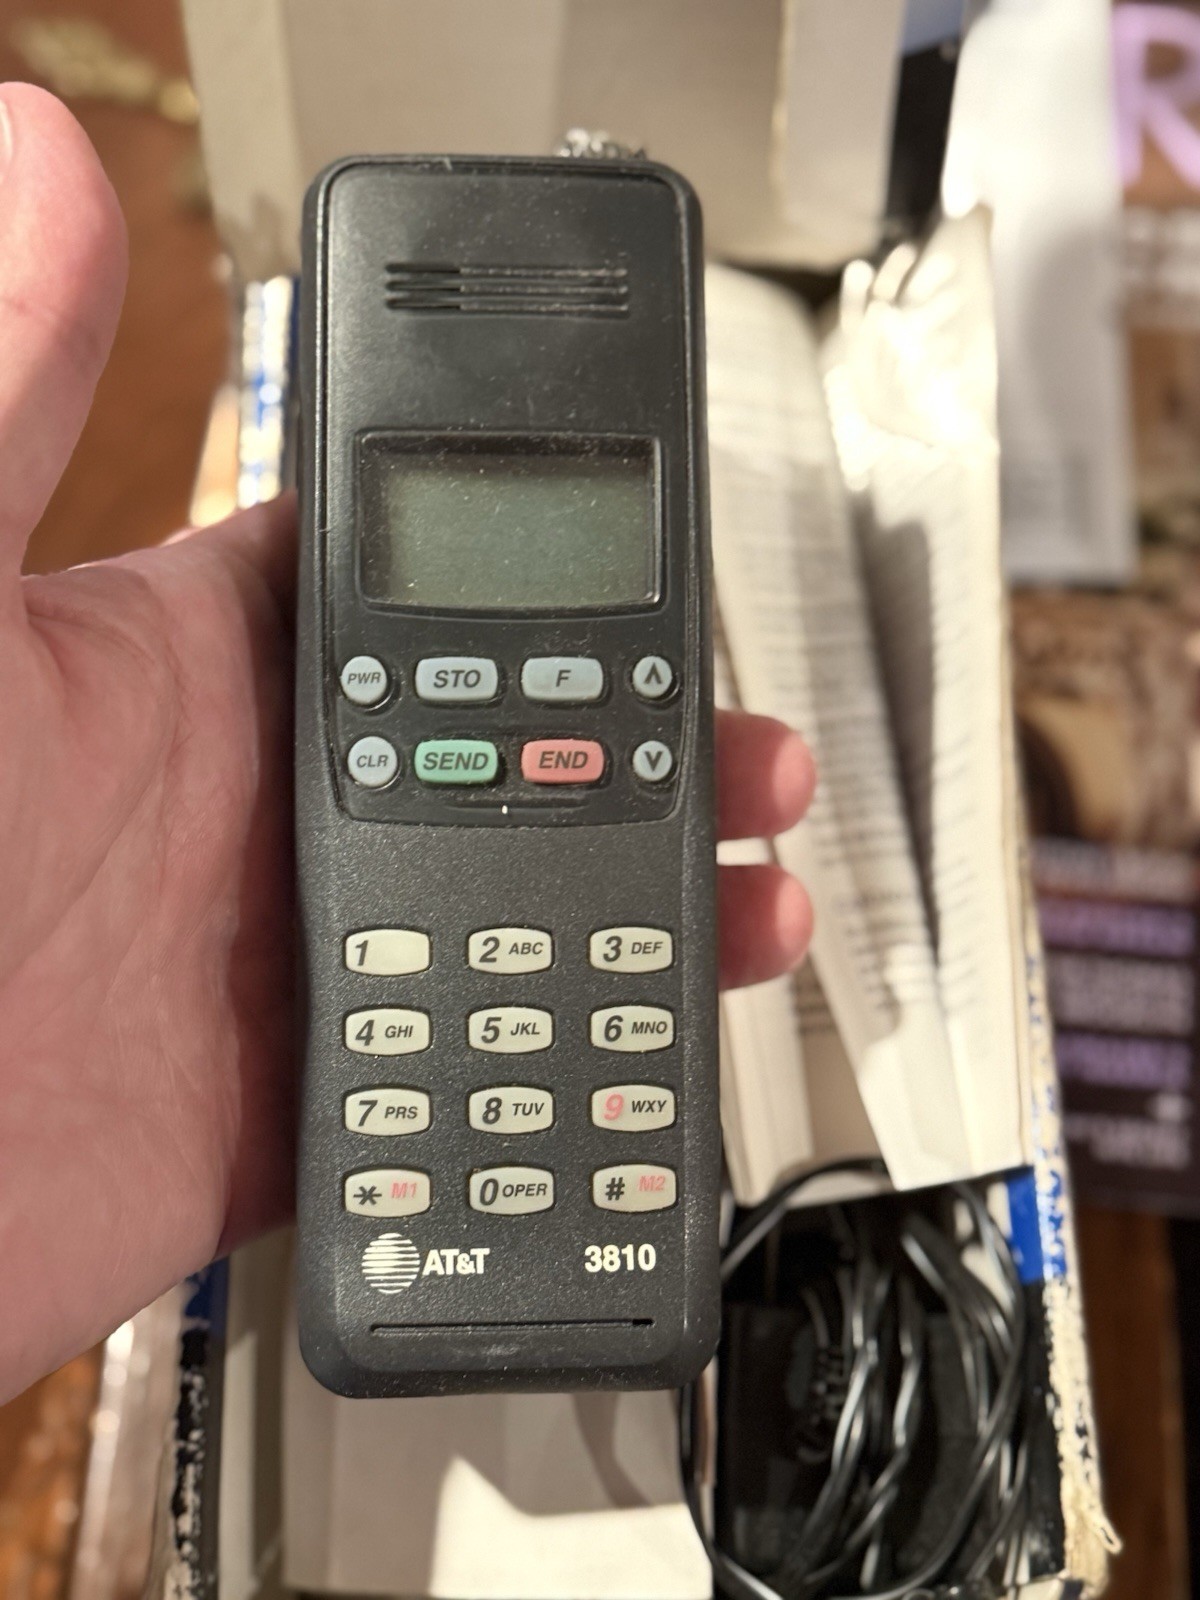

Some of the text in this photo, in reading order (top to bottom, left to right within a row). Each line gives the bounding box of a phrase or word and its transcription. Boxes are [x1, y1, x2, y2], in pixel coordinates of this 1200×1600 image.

[346, 671, 381, 685] PWR
[433, 669, 481, 689] STO
[556, 669, 571, 687] F
[355, 753, 389, 770] CLR
[422, 751, 489, 772] SEND
[539, 750, 588, 769] END
[354, 940, 370, 966] 1
[479, 936, 544, 963] 2 ABC
[603, 935, 663, 962] 3 DEF
[355, 1019, 413, 1046] 4 GHI
[481, 1016, 541, 1044] 5 JKL
[603, 1015, 668, 1042] 6 MNO
[357, 1100, 418, 1127] 7 PRS
[482, 1097, 545, 1125] 8 TUV
[603, 1093, 668, 1121] 9 WXY
[391, 1182, 418, 1199] M1
[479, 1178, 547, 1206] 0 OPER
[605, 1175, 666, 1200] # M2
[422, 1248, 490, 1275] AT&T
[584, 1243, 656, 1273] 3810
